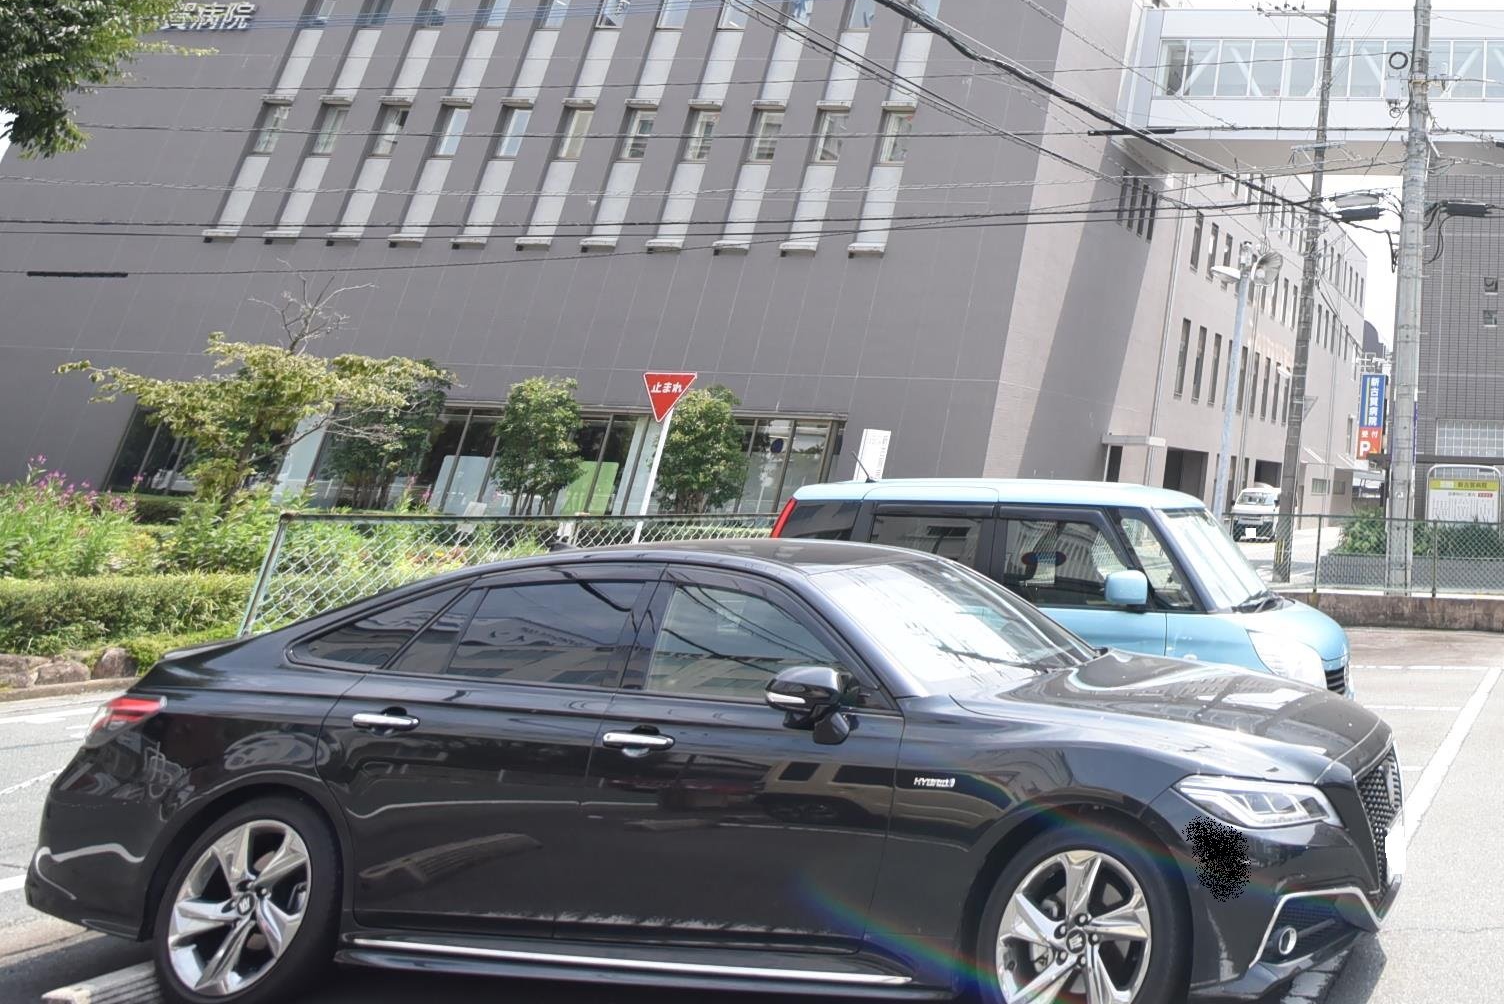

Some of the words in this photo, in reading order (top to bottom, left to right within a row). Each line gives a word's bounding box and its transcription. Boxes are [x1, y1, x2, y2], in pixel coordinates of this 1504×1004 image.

[650, 382, 682, 393] 止まれ
[1368, 377, 1380, 427] 新古賀病院
[1360, 440, 1371, 456] P
